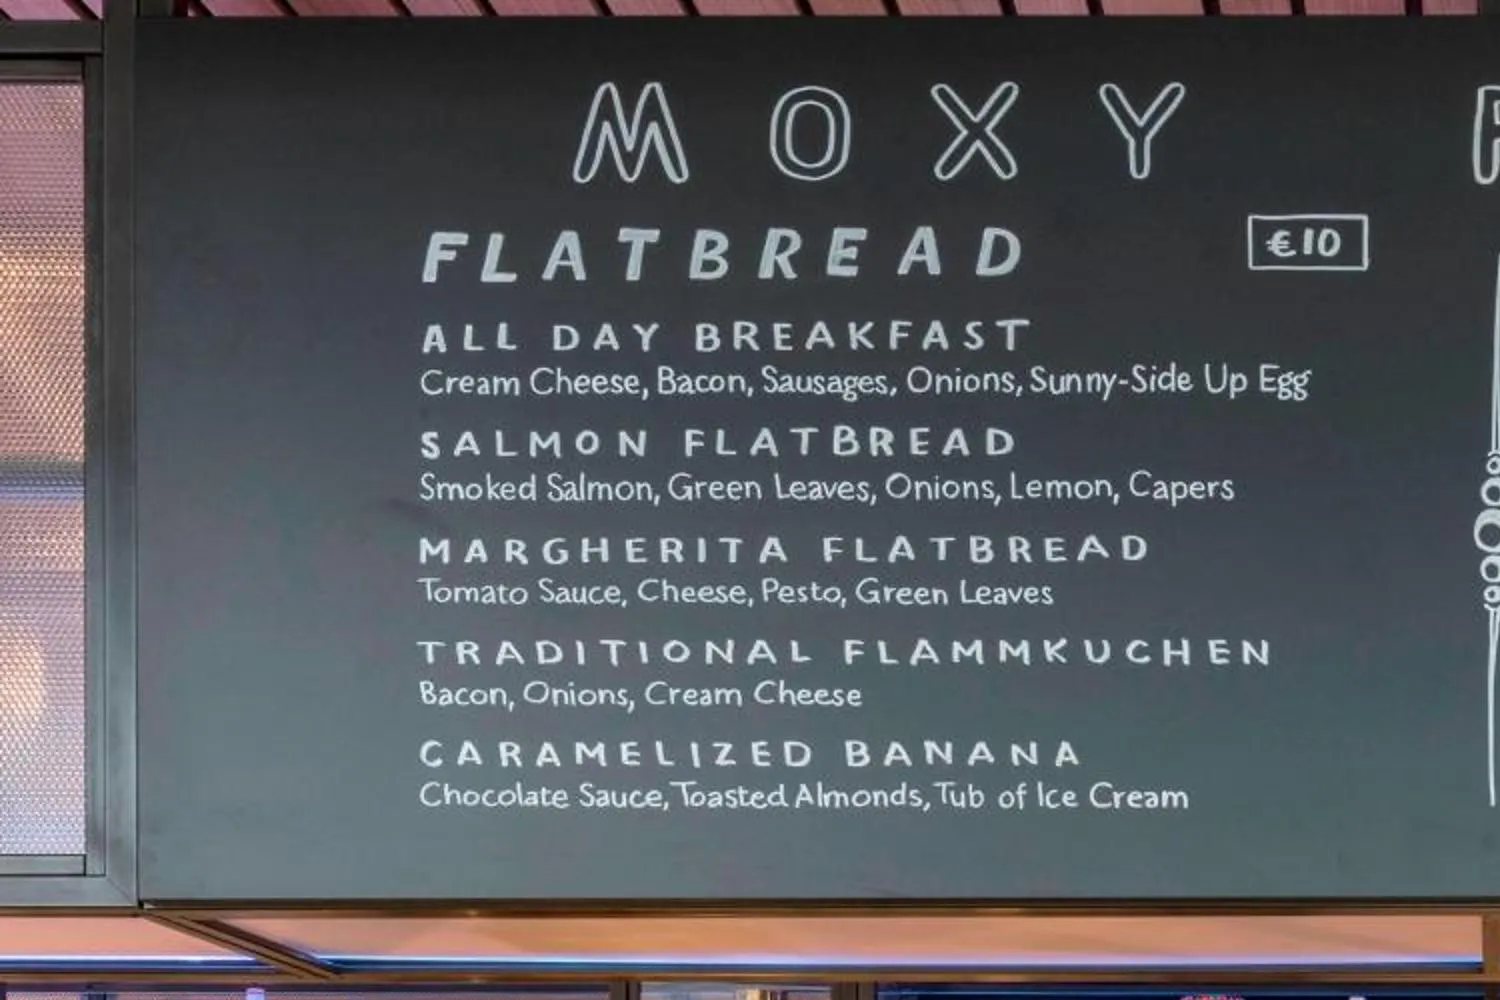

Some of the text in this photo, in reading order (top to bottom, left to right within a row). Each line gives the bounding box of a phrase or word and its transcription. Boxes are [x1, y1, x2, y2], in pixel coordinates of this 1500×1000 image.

[572, 80, 1186, 185] MOXY
[421, 225, 1022, 283] FLATBREAD
[421, 318, 1031, 354] ALL DAY BREAKFAST
[419, 361, 1313, 403] Cream Cheese, Bacon, Sausages, Onions, Sunny-Side Up Egg
[420, 424, 1015, 460] SALMON FLATBREAD
[419, 469, 1235, 508] Smoked Salmon, Green Leaves, Onions, Lemon, Capers
[419, 534, 1148, 565] MARGHERITA FLATBREAD
[416, 576, 1054, 609] Tomato Sauce, Cheese, Pesto, Green Leaves
[416, 637, 1269, 667] TRADITIONAL FLAMMKUCHEN
[419, 679, 863, 714] Bacon, Onions, Cream Cheese
[419, 739, 1080, 769] CARAMELIZED BANANA
[419, 780, 1189, 812] Chocolate Sauce, Toasted Almonds, Tub of Ice Cream
